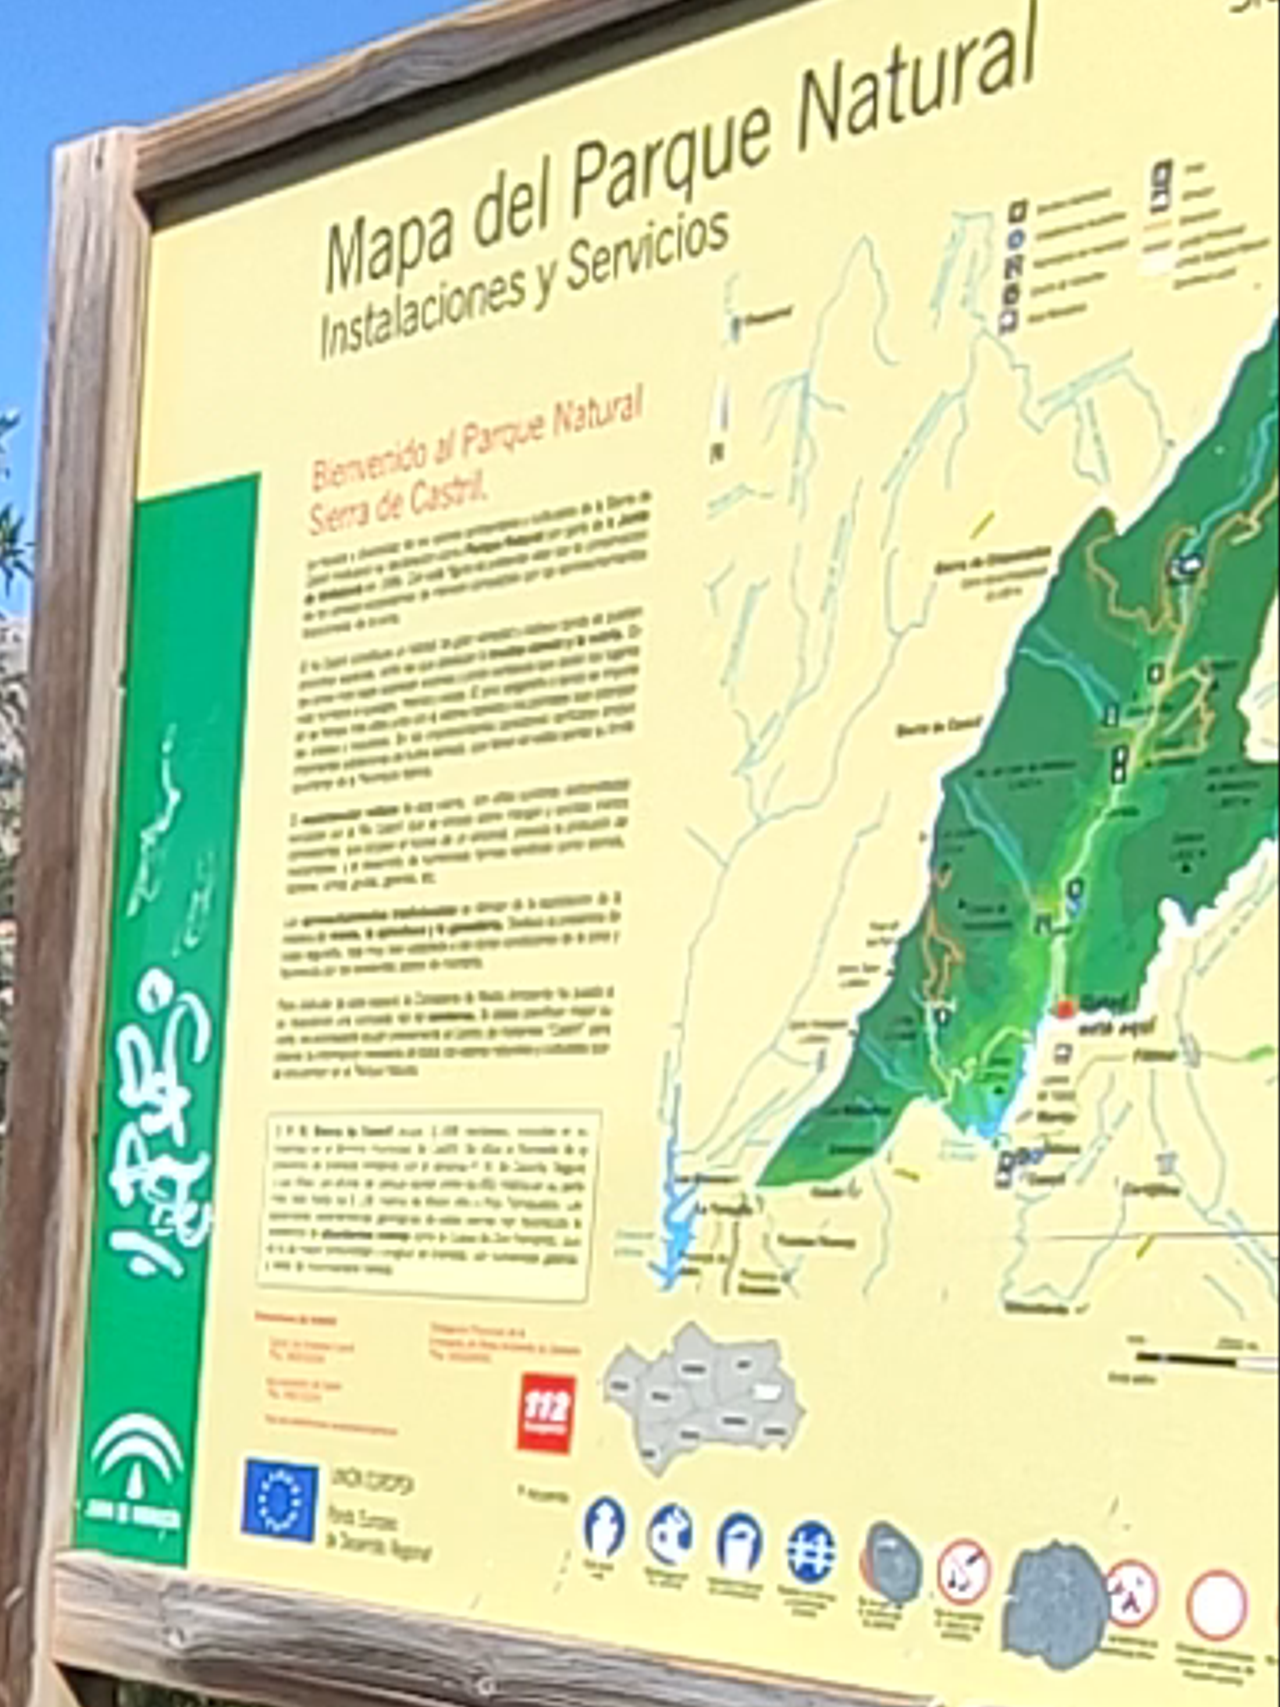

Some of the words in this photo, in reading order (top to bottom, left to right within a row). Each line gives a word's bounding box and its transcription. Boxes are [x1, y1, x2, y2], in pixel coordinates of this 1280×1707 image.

[326, 207, 454, 294] Mapa
[474, 154, 551, 248] del
[574, 107, 771, 219] Parque
[320, 270, 526, 360] Instalaciones
[534, 261, 557, 312] y
[567, 209, 729, 291] Servicios
[311, 438, 427, 493] Bienvenido
[434, 428, 456, 465] al
[461, 415, 545, 457] Parque
[553, 382, 643, 436] Natural
[308, 501, 370, 537] Sierra
[375, 490, 405, 522] de
[525, 1390, 571, 1422] 112
